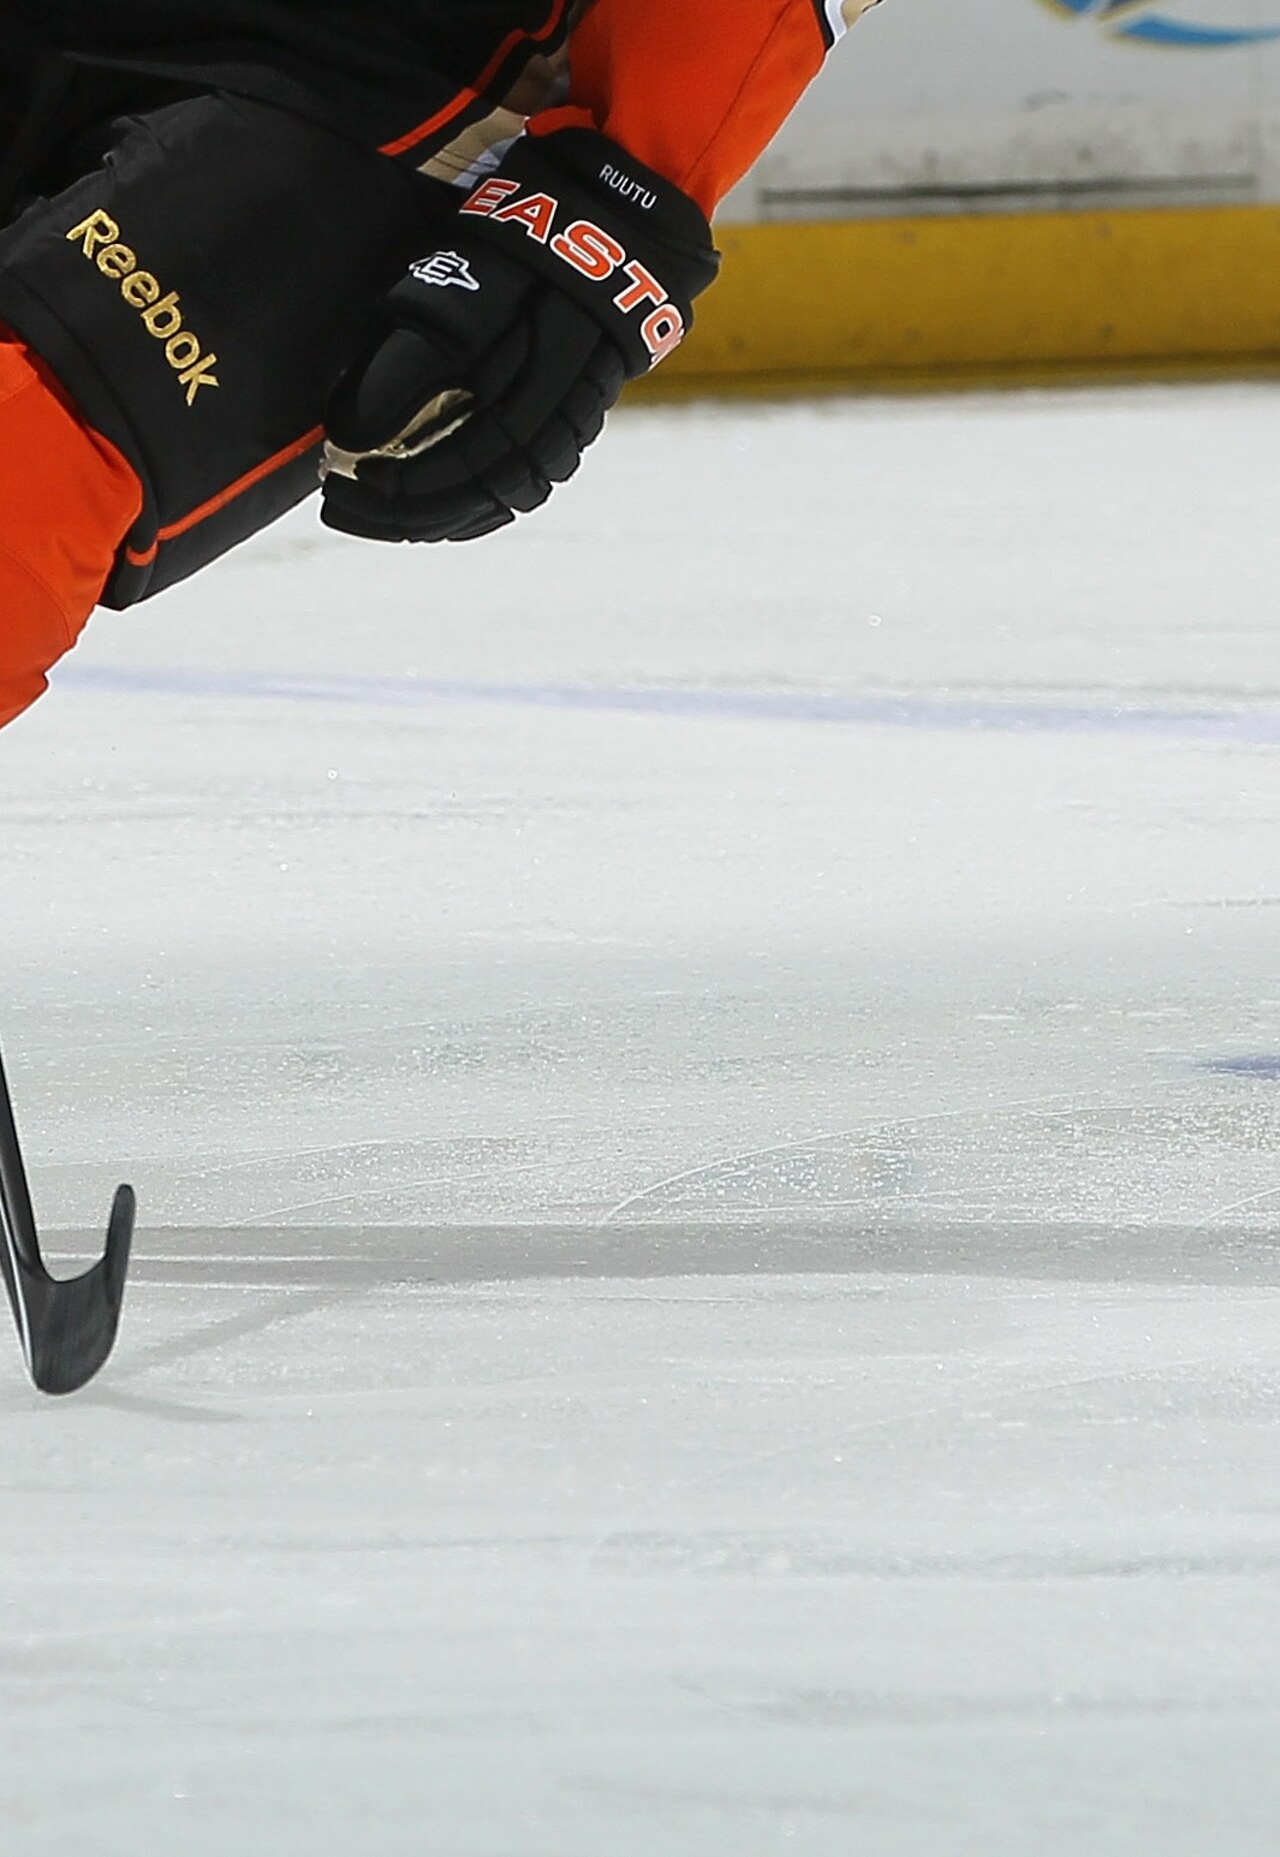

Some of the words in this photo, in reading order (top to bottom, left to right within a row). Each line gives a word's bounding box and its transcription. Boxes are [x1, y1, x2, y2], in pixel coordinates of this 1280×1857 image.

[458, 177, 685, 371] EASTO
[599, 163, 658, 210] RUUTU
[65, 208, 220, 407] Reebok
